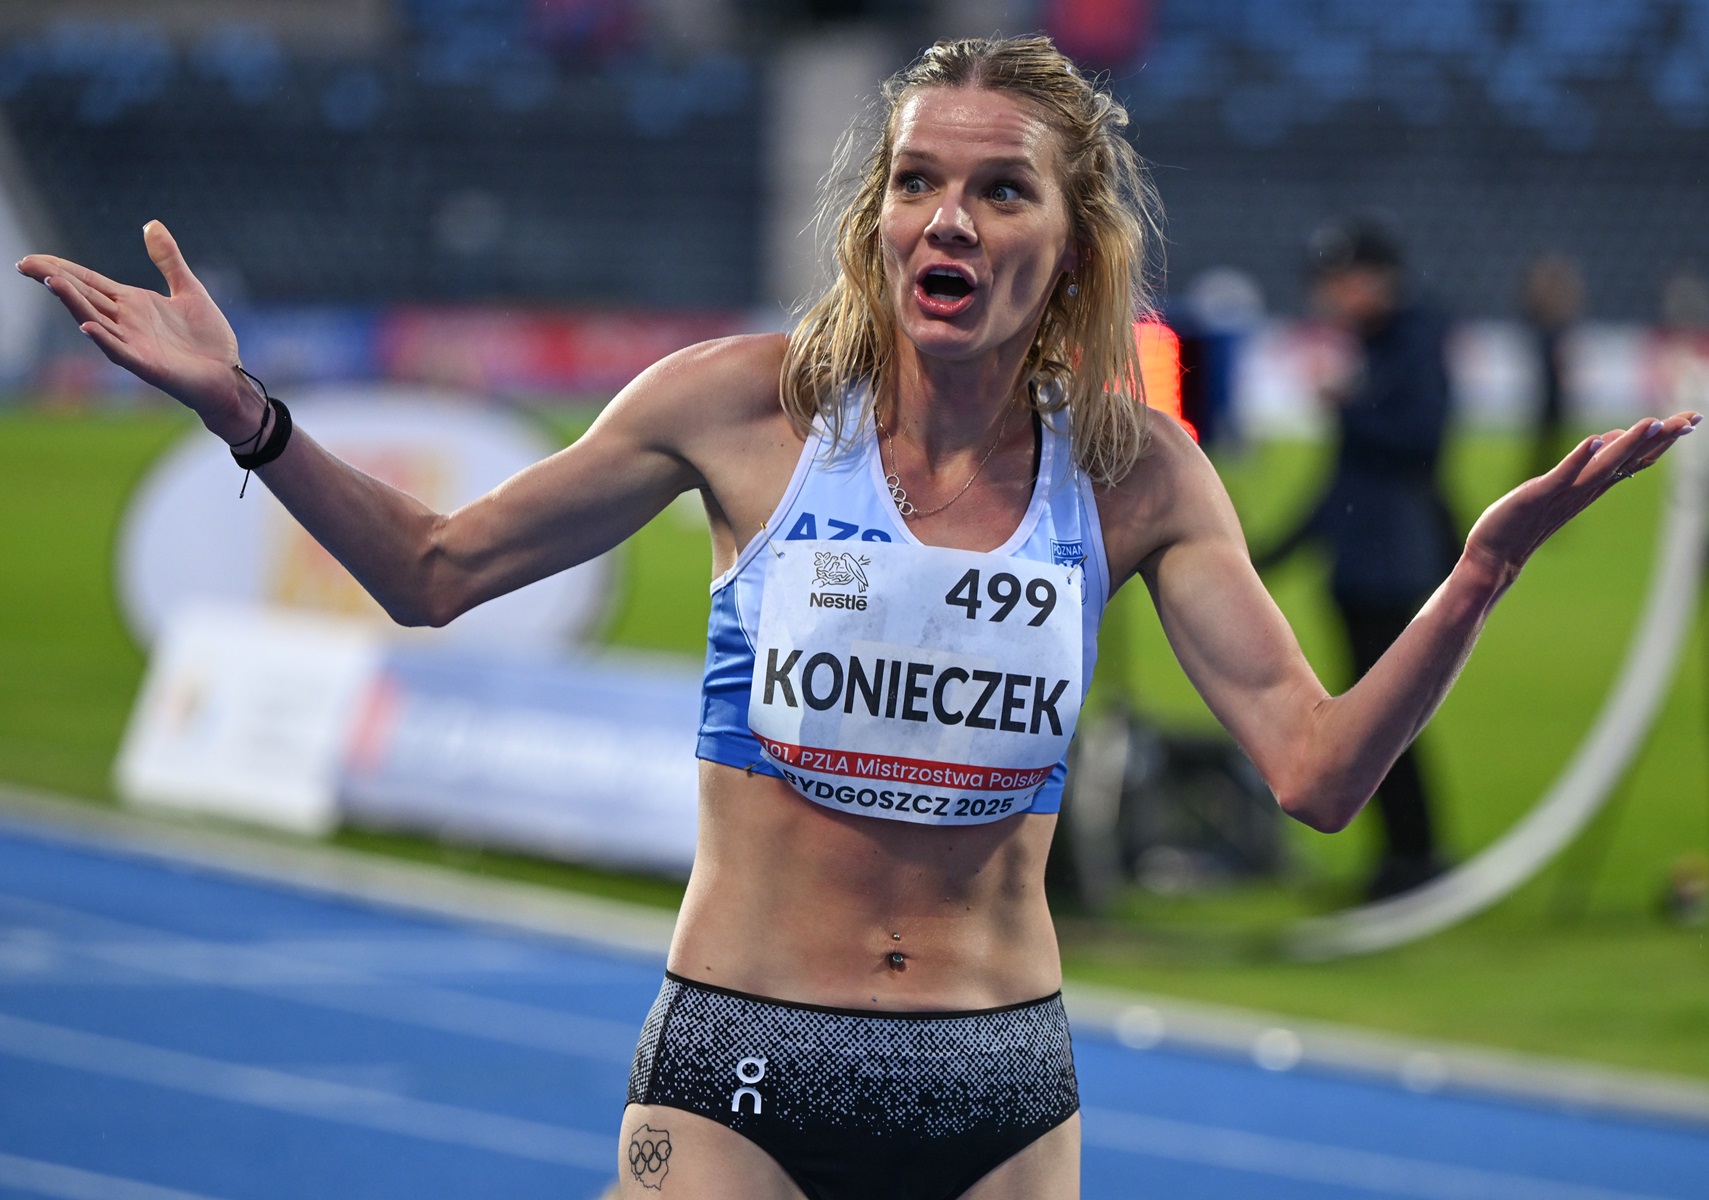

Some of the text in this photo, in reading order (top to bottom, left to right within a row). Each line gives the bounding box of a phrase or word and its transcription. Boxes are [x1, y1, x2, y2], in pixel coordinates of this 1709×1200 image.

[945, 568, 1057, 627] 499
[762, 648, 1070, 736] KONIECZEK
[763, 740, 1044, 788] 101. PZLA Mistrzostwa Polski
[783, 768, 1014, 817] BYDGOSZCZ 2025
